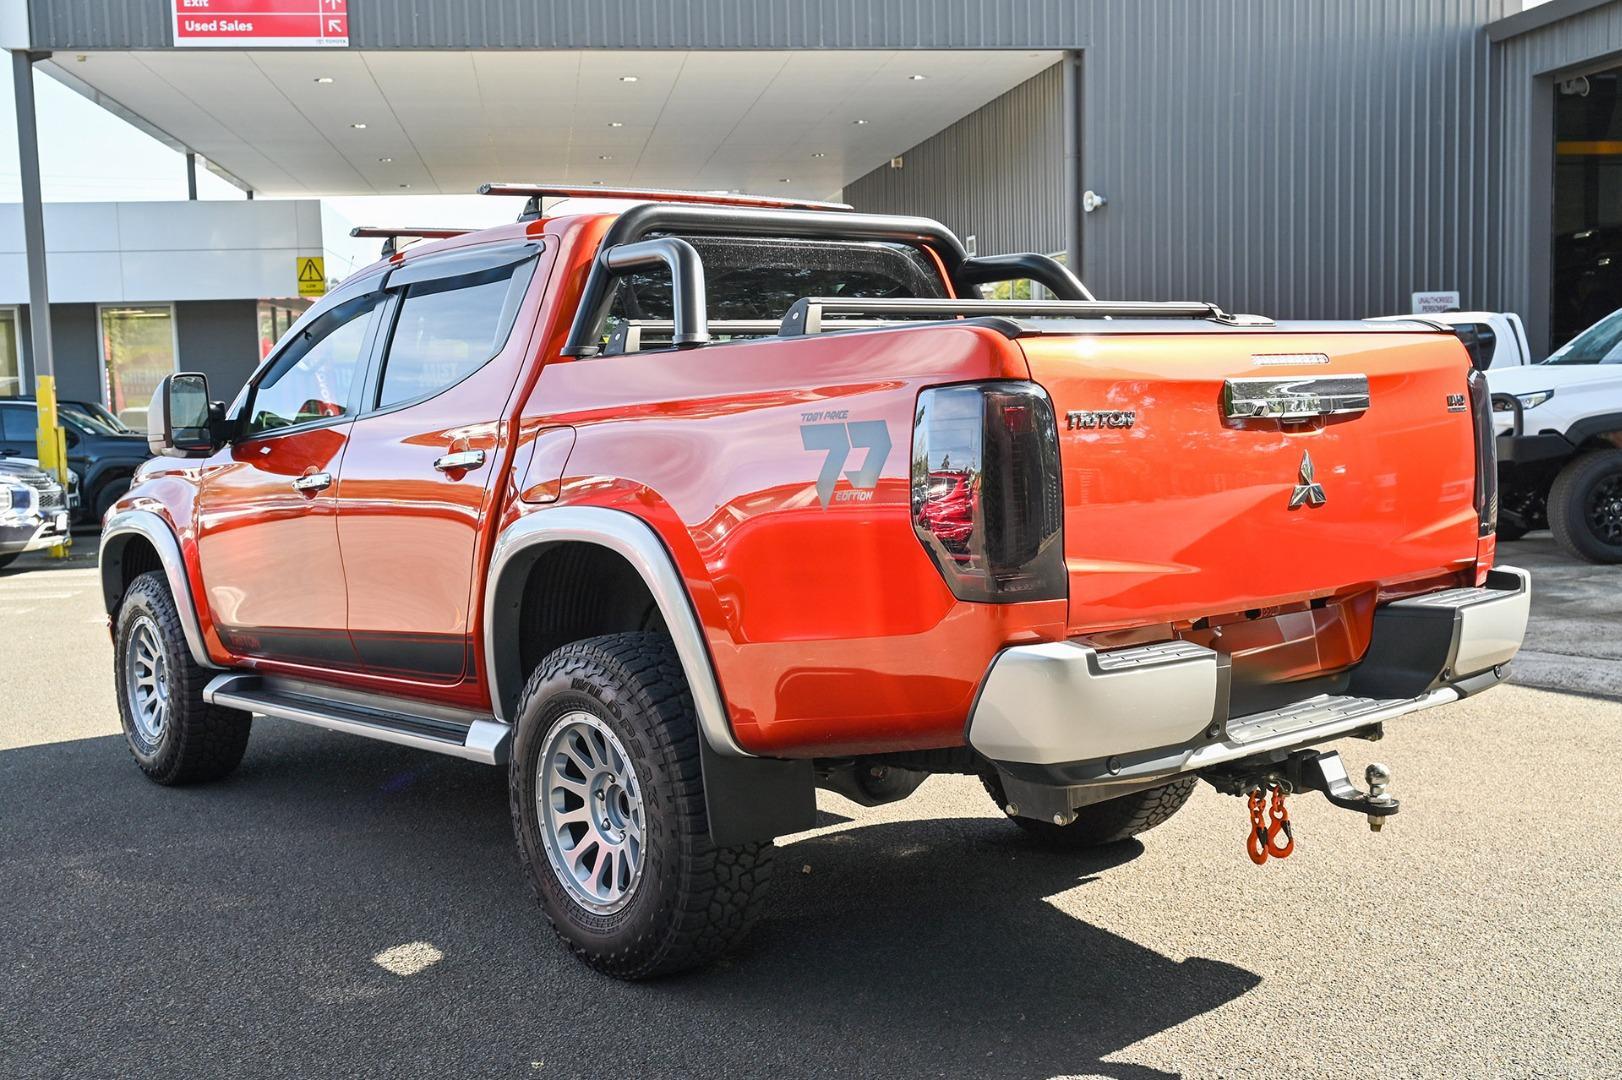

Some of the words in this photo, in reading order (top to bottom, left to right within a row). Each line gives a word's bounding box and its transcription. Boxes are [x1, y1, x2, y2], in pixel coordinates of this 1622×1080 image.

[185, 20, 217, 32] Used
[219, 20, 253, 32] Sales
[824, 410, 849, 420] PRICE
[800, 420, 892, 512] 77
[835, 491, 874, 501] EDITION
